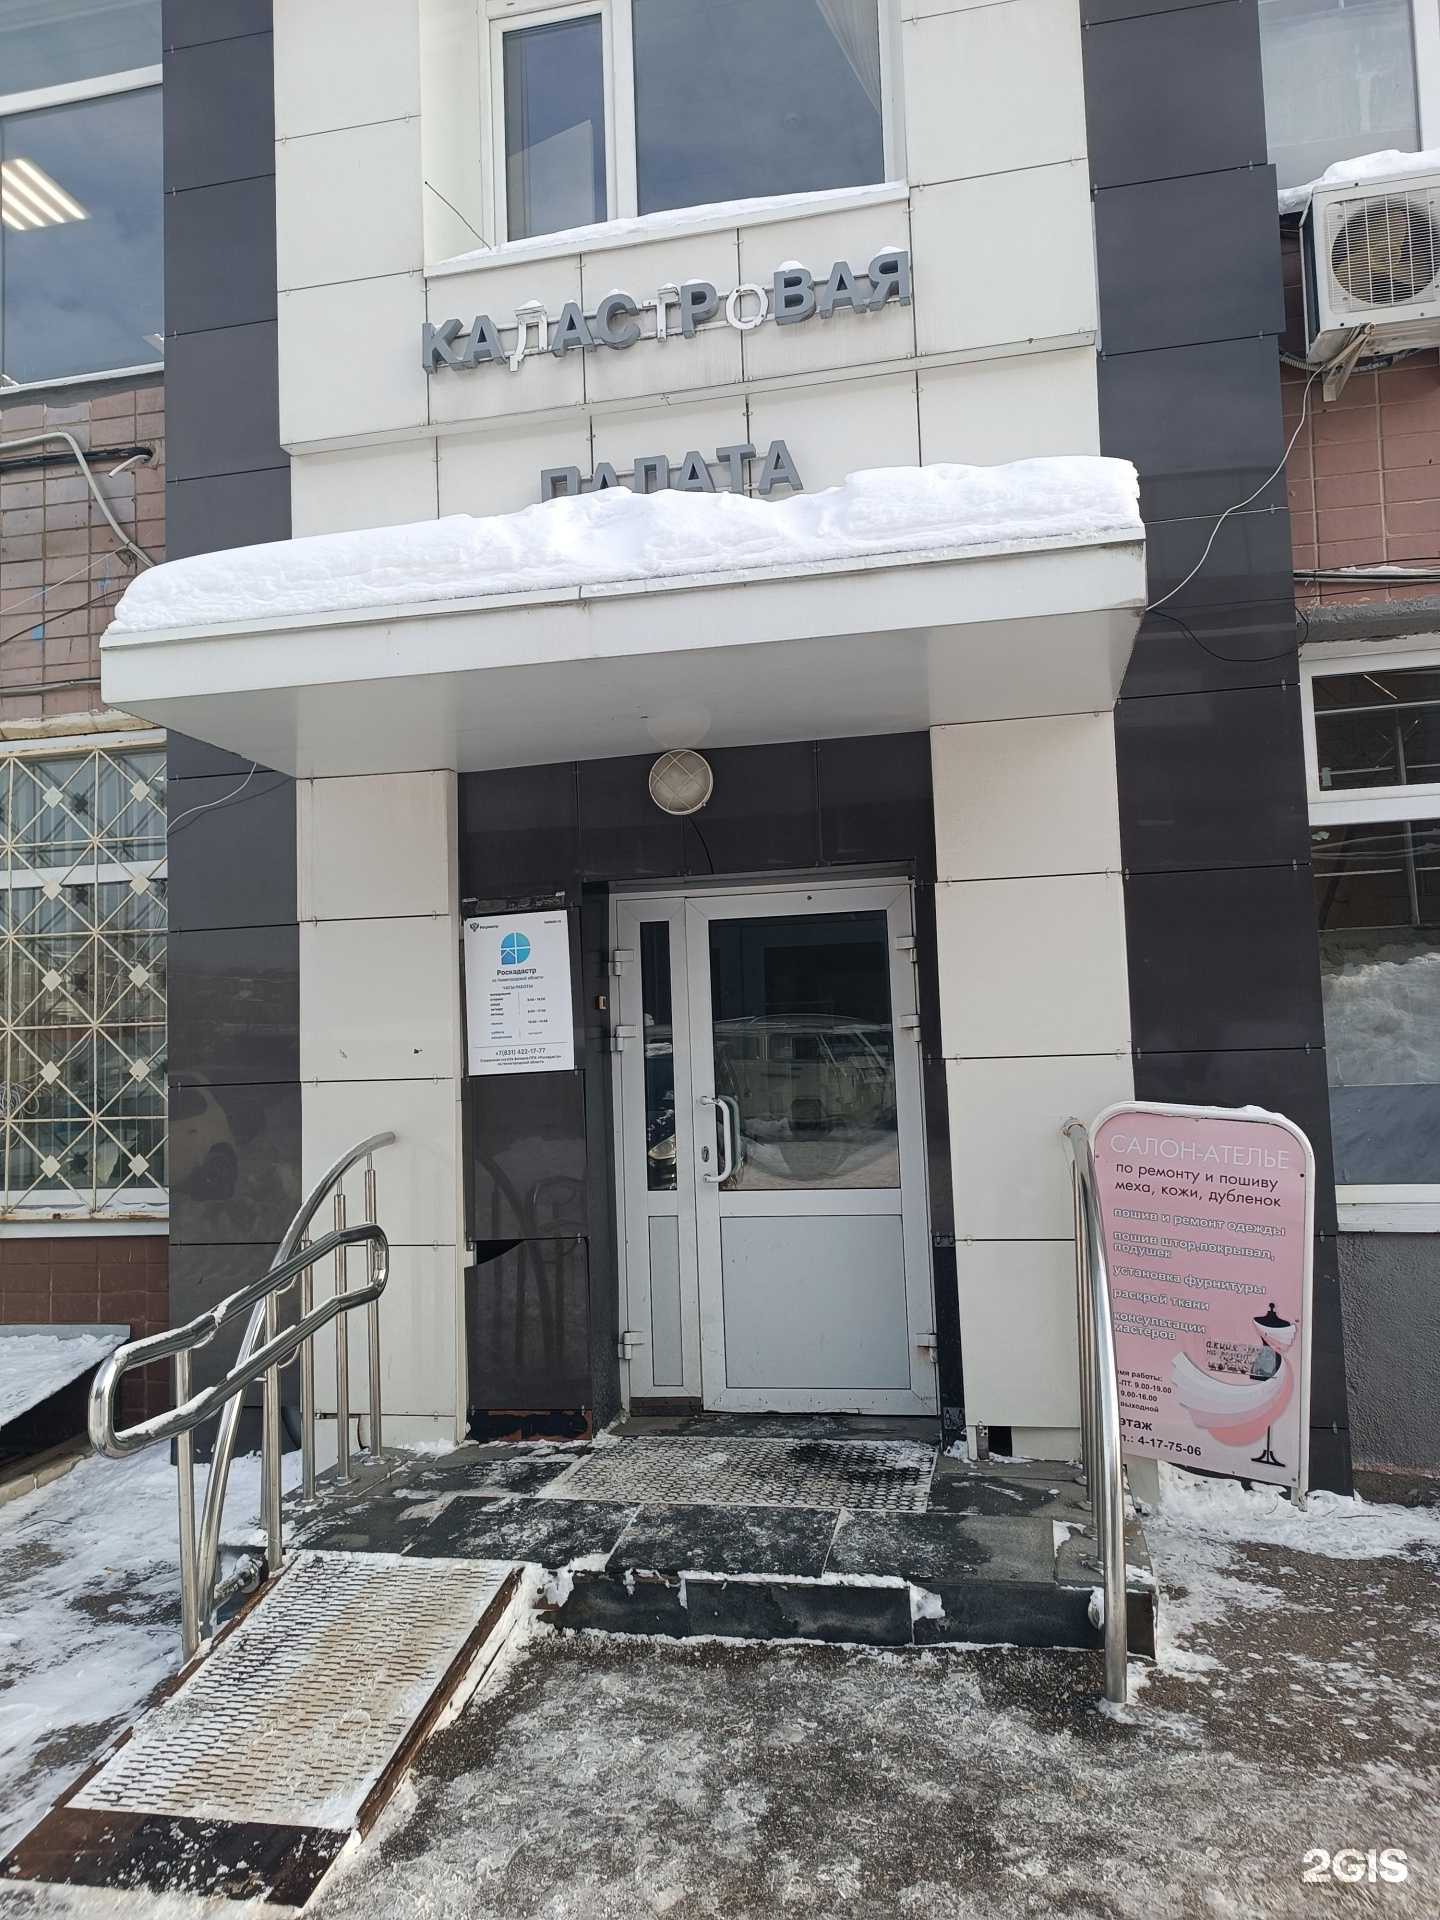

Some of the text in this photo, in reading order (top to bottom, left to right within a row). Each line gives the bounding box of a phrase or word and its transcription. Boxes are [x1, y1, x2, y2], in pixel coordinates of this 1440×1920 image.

[422, 250, 911, 373] КАДАСТРОВАЯ
[496, 968, 537, 976] Роскадастр
[1110, 1134, 1289, 1169] САЛОН-АТЕЛЬЕ
[1116, 1163, 1279, 1192] по ремонту и пошиву
[1115, 1181, 1281, 1207] меха, кожи, дубленок
[1113, 1208, 1286, 1236] пошив и ремонт одежды
[1113, 1231, 1158, 1245] пошив
[1113, 1242, 1172, 1259] подушек
[1113, 1265, 1267, 1295] установка фурнитуры
[1113, 1288, 1210, 1311] раскрой ткани
[1113, 1311, 1207, 1334] консультации
[1114, 1323, 1177, 1340] мастеров
[1131, 1372, 1163, 1381] работы:
[1120, 1417, 1152, 1431] этаж
[1120, 1434, 1202, 1456] л.: 4-17-75-06
